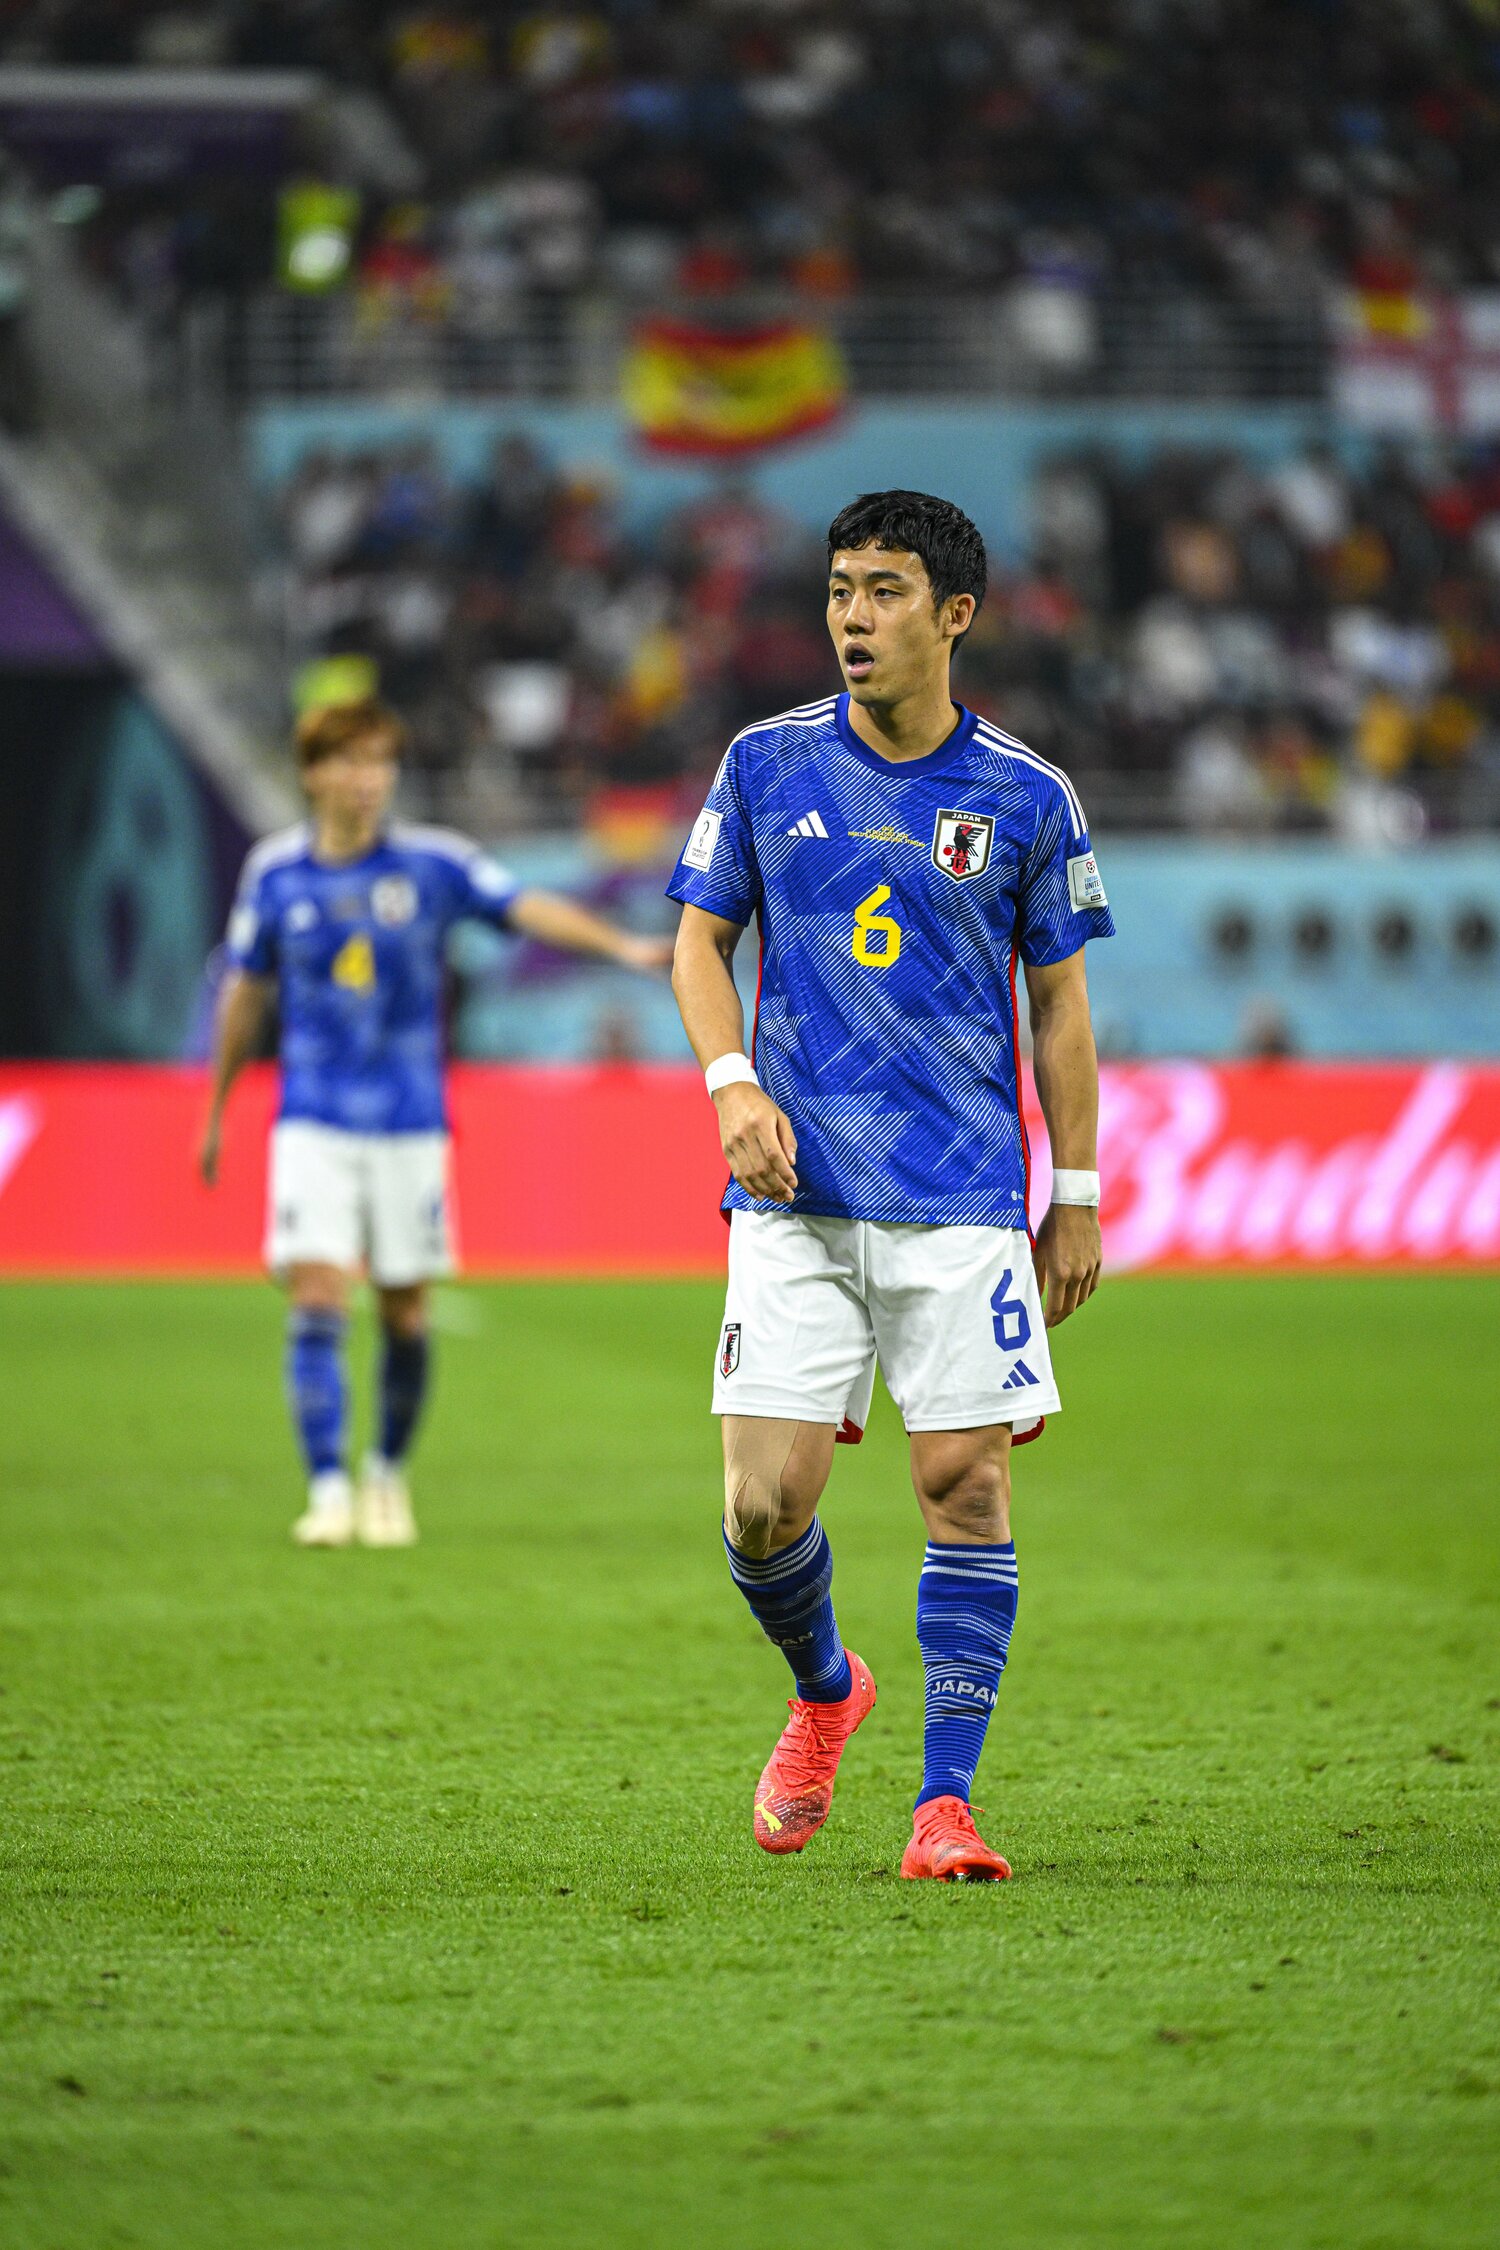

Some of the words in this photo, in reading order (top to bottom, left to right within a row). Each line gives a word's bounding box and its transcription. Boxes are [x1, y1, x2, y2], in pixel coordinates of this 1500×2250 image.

[951, 813, 981, 822] JAPAN
[946, 857, 971, 871] JFA
[852, 885, 902, 968] 6
[331, 932, 377, 995] 4
[990, 1268, 1032, 1352] 6
[931, 1679, 998, 1706] JAPAN
